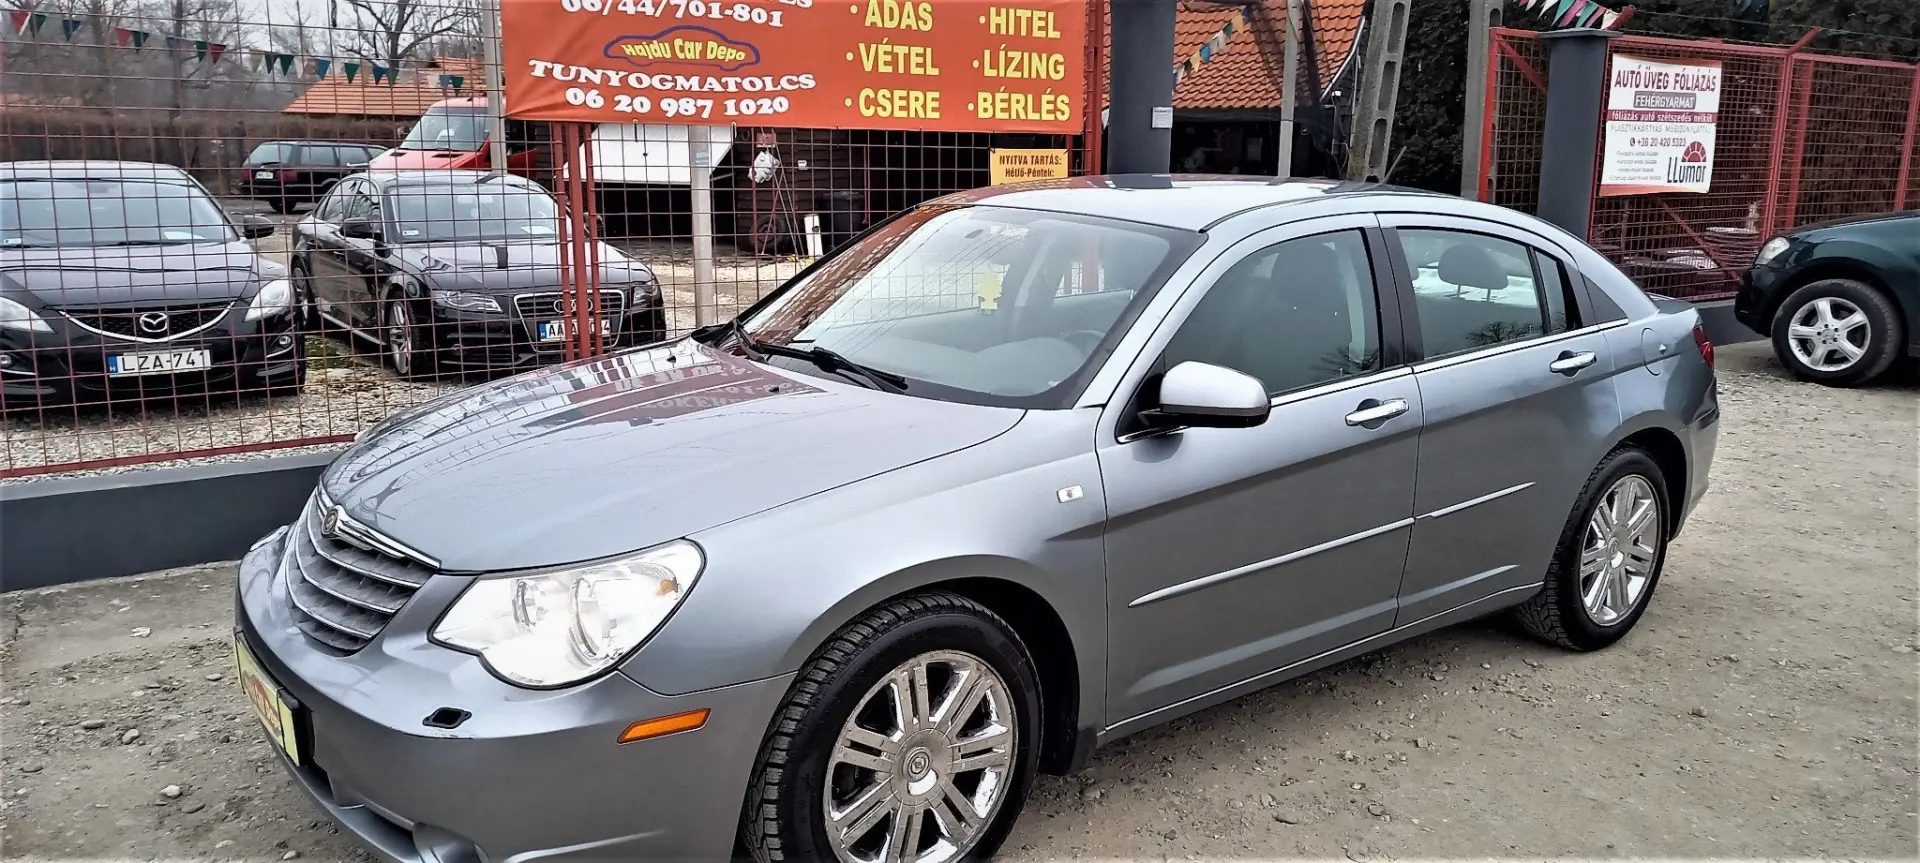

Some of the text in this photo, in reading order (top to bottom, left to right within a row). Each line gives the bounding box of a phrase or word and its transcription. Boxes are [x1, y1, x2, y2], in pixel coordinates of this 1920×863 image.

[989, 6, 1061, 39] HITEL
[621, 38, 746, 62] Hajdu Car Depo
[858, 37, 940, 76] VÉTEL
[983, 43, 1065, 81] LÍZING
[528, 59, 817, 92] TUNYOGMATOLCS
[1614, 65, 1641, 89] AUTÓ
[1673, 67, 1717, 92] FÓLIÁZÁS
[565, 87, 790, 118] 06 20 987 1020
[858, 87, 940, 119] CSERE
[977, 86, 1071, 122] BÉRLÉS
[1634, 93, 1695, 109] FEHÉRGYARMAT
[1640, 111, 1655, 121] autó
[999, 153, 1062, 165] NYITVA TARTÁS:
[1666, 157, 1707, 184] LLumar
